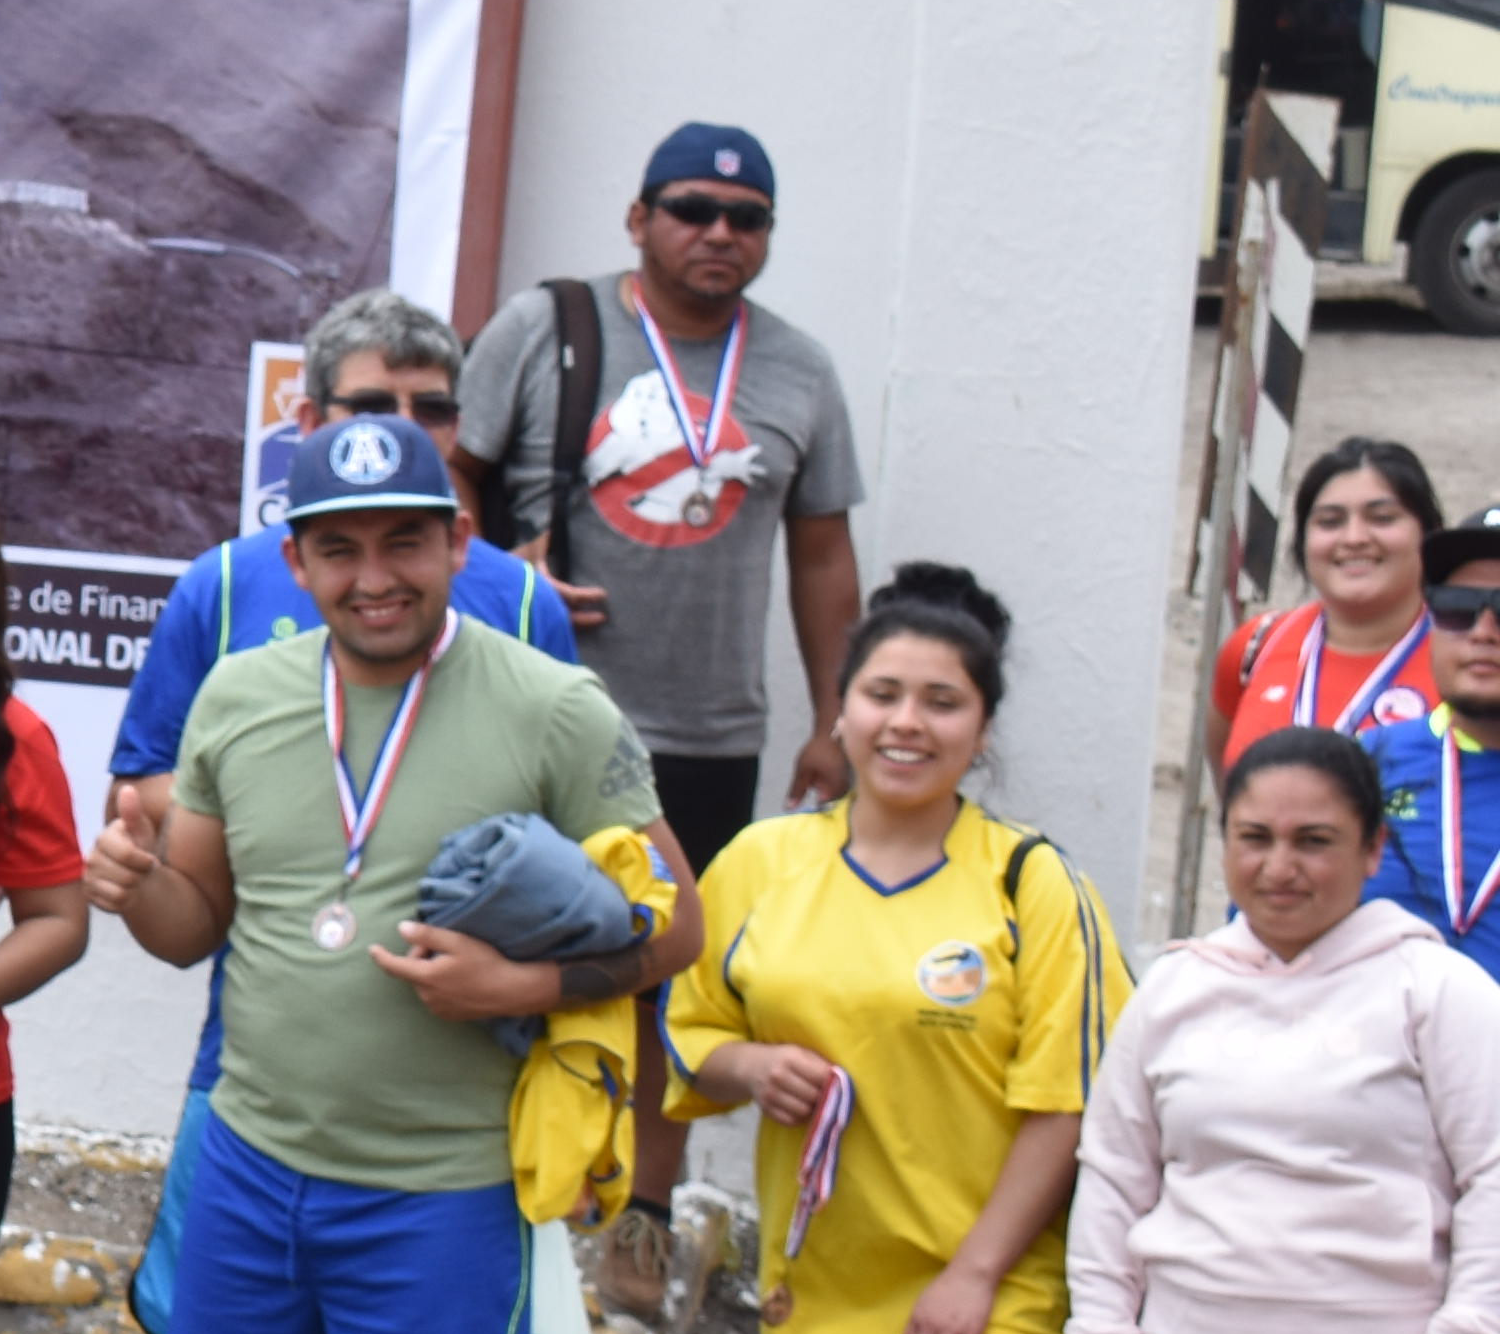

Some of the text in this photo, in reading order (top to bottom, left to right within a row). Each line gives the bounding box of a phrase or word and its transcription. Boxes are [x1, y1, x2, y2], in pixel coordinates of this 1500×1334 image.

[29, 580, 72, 615] de
[80, 584, 168, 622] Finan
[4, 625, 102, 667] ONAL
